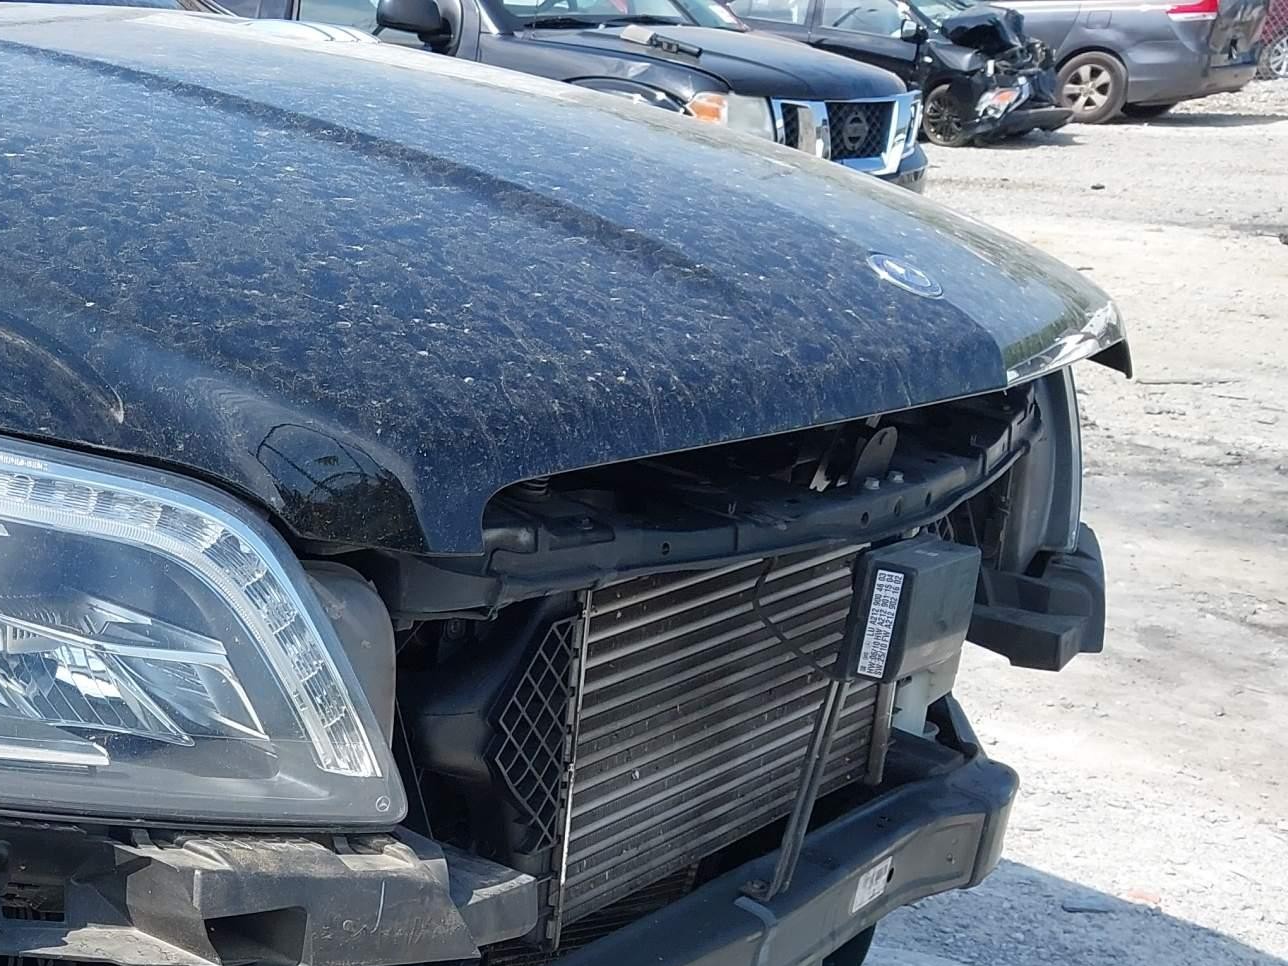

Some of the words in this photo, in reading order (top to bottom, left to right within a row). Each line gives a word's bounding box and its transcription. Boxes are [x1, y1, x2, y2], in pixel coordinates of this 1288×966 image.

[869, 608, 879, 625] A212
[877, 609, 887, 626] A212
[884, 611, 894, 629] A212
